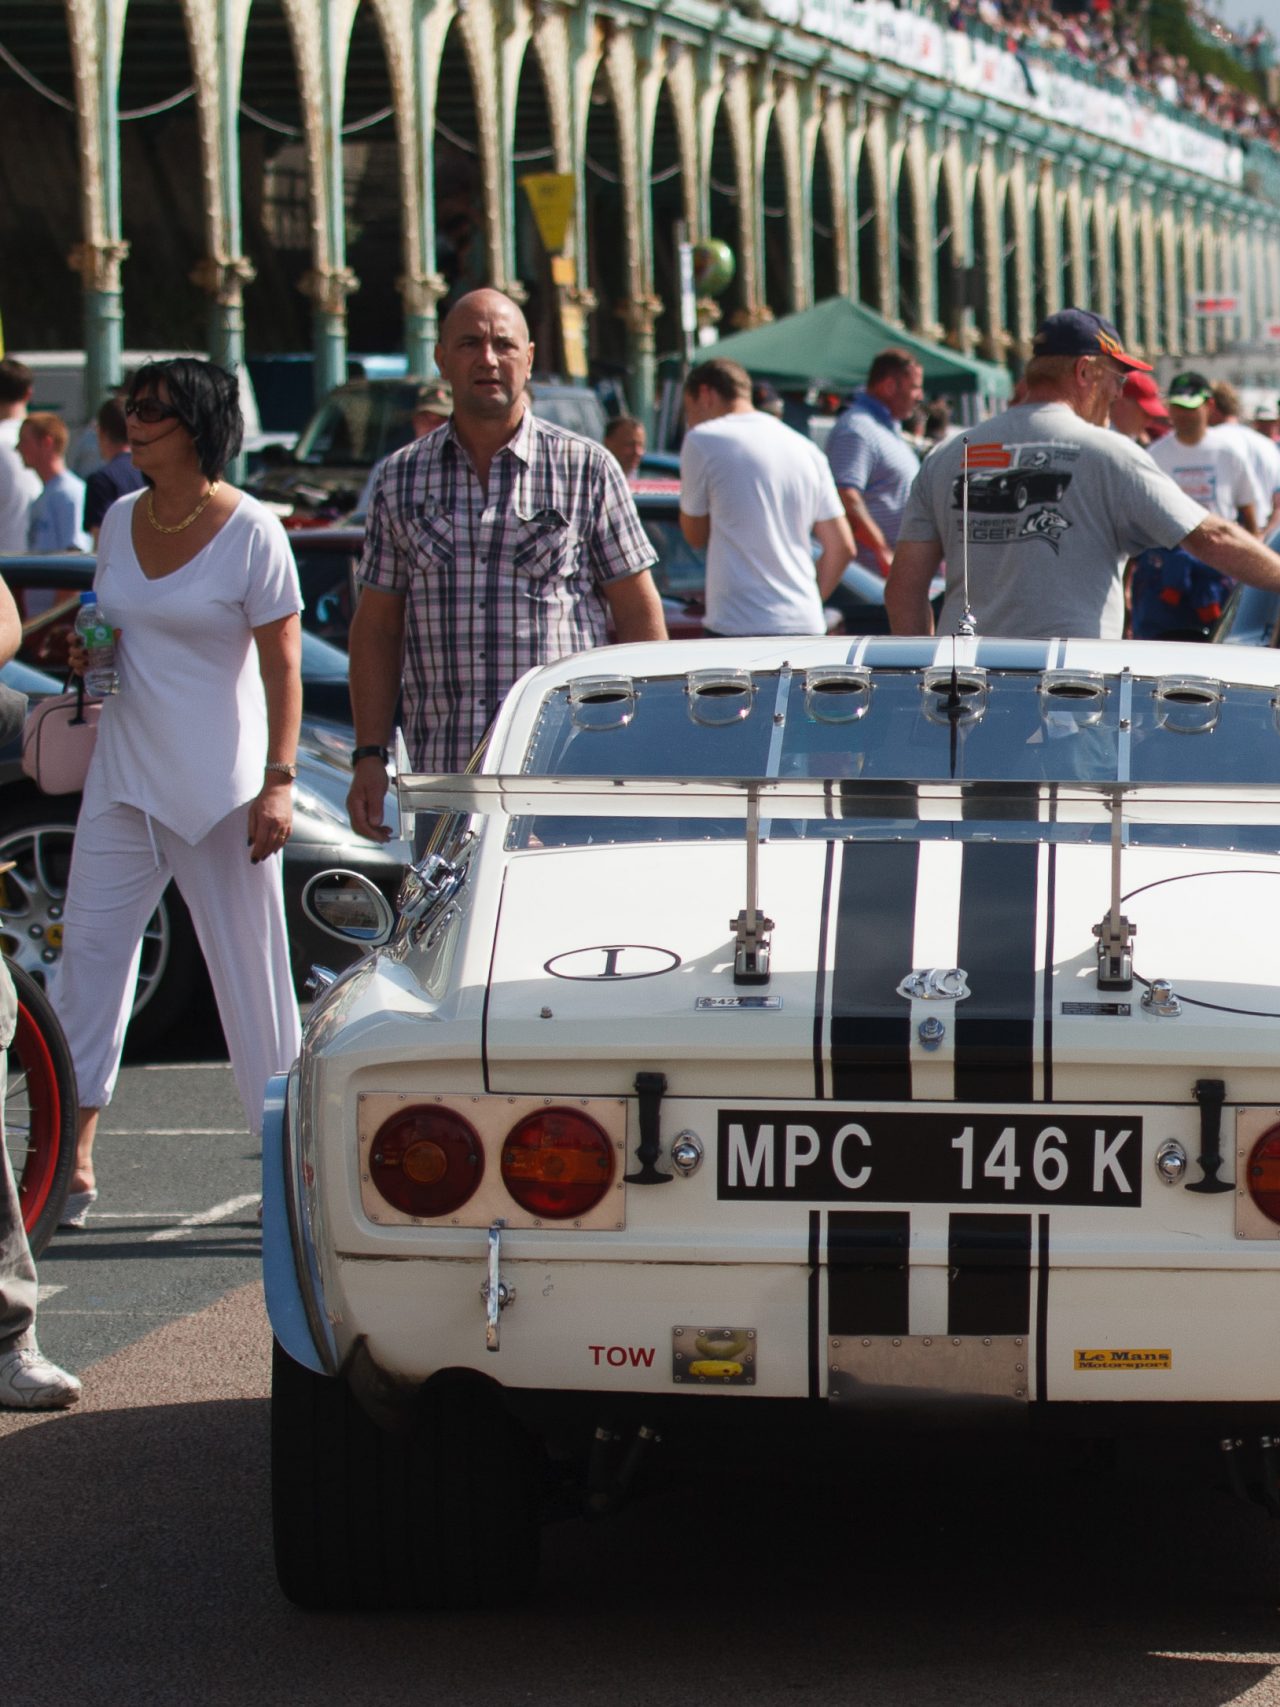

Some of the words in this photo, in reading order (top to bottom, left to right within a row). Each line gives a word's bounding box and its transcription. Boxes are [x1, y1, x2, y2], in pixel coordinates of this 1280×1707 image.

[728, 1124, 872, 1189] MPC
[588, 1345, 656, 1367] TOW
[1078, 1352, 1105, 1361] Le
[1110, 1351, 1169, 1361] Mans
[1078, 1361, 1169, 1369] Motorsport
